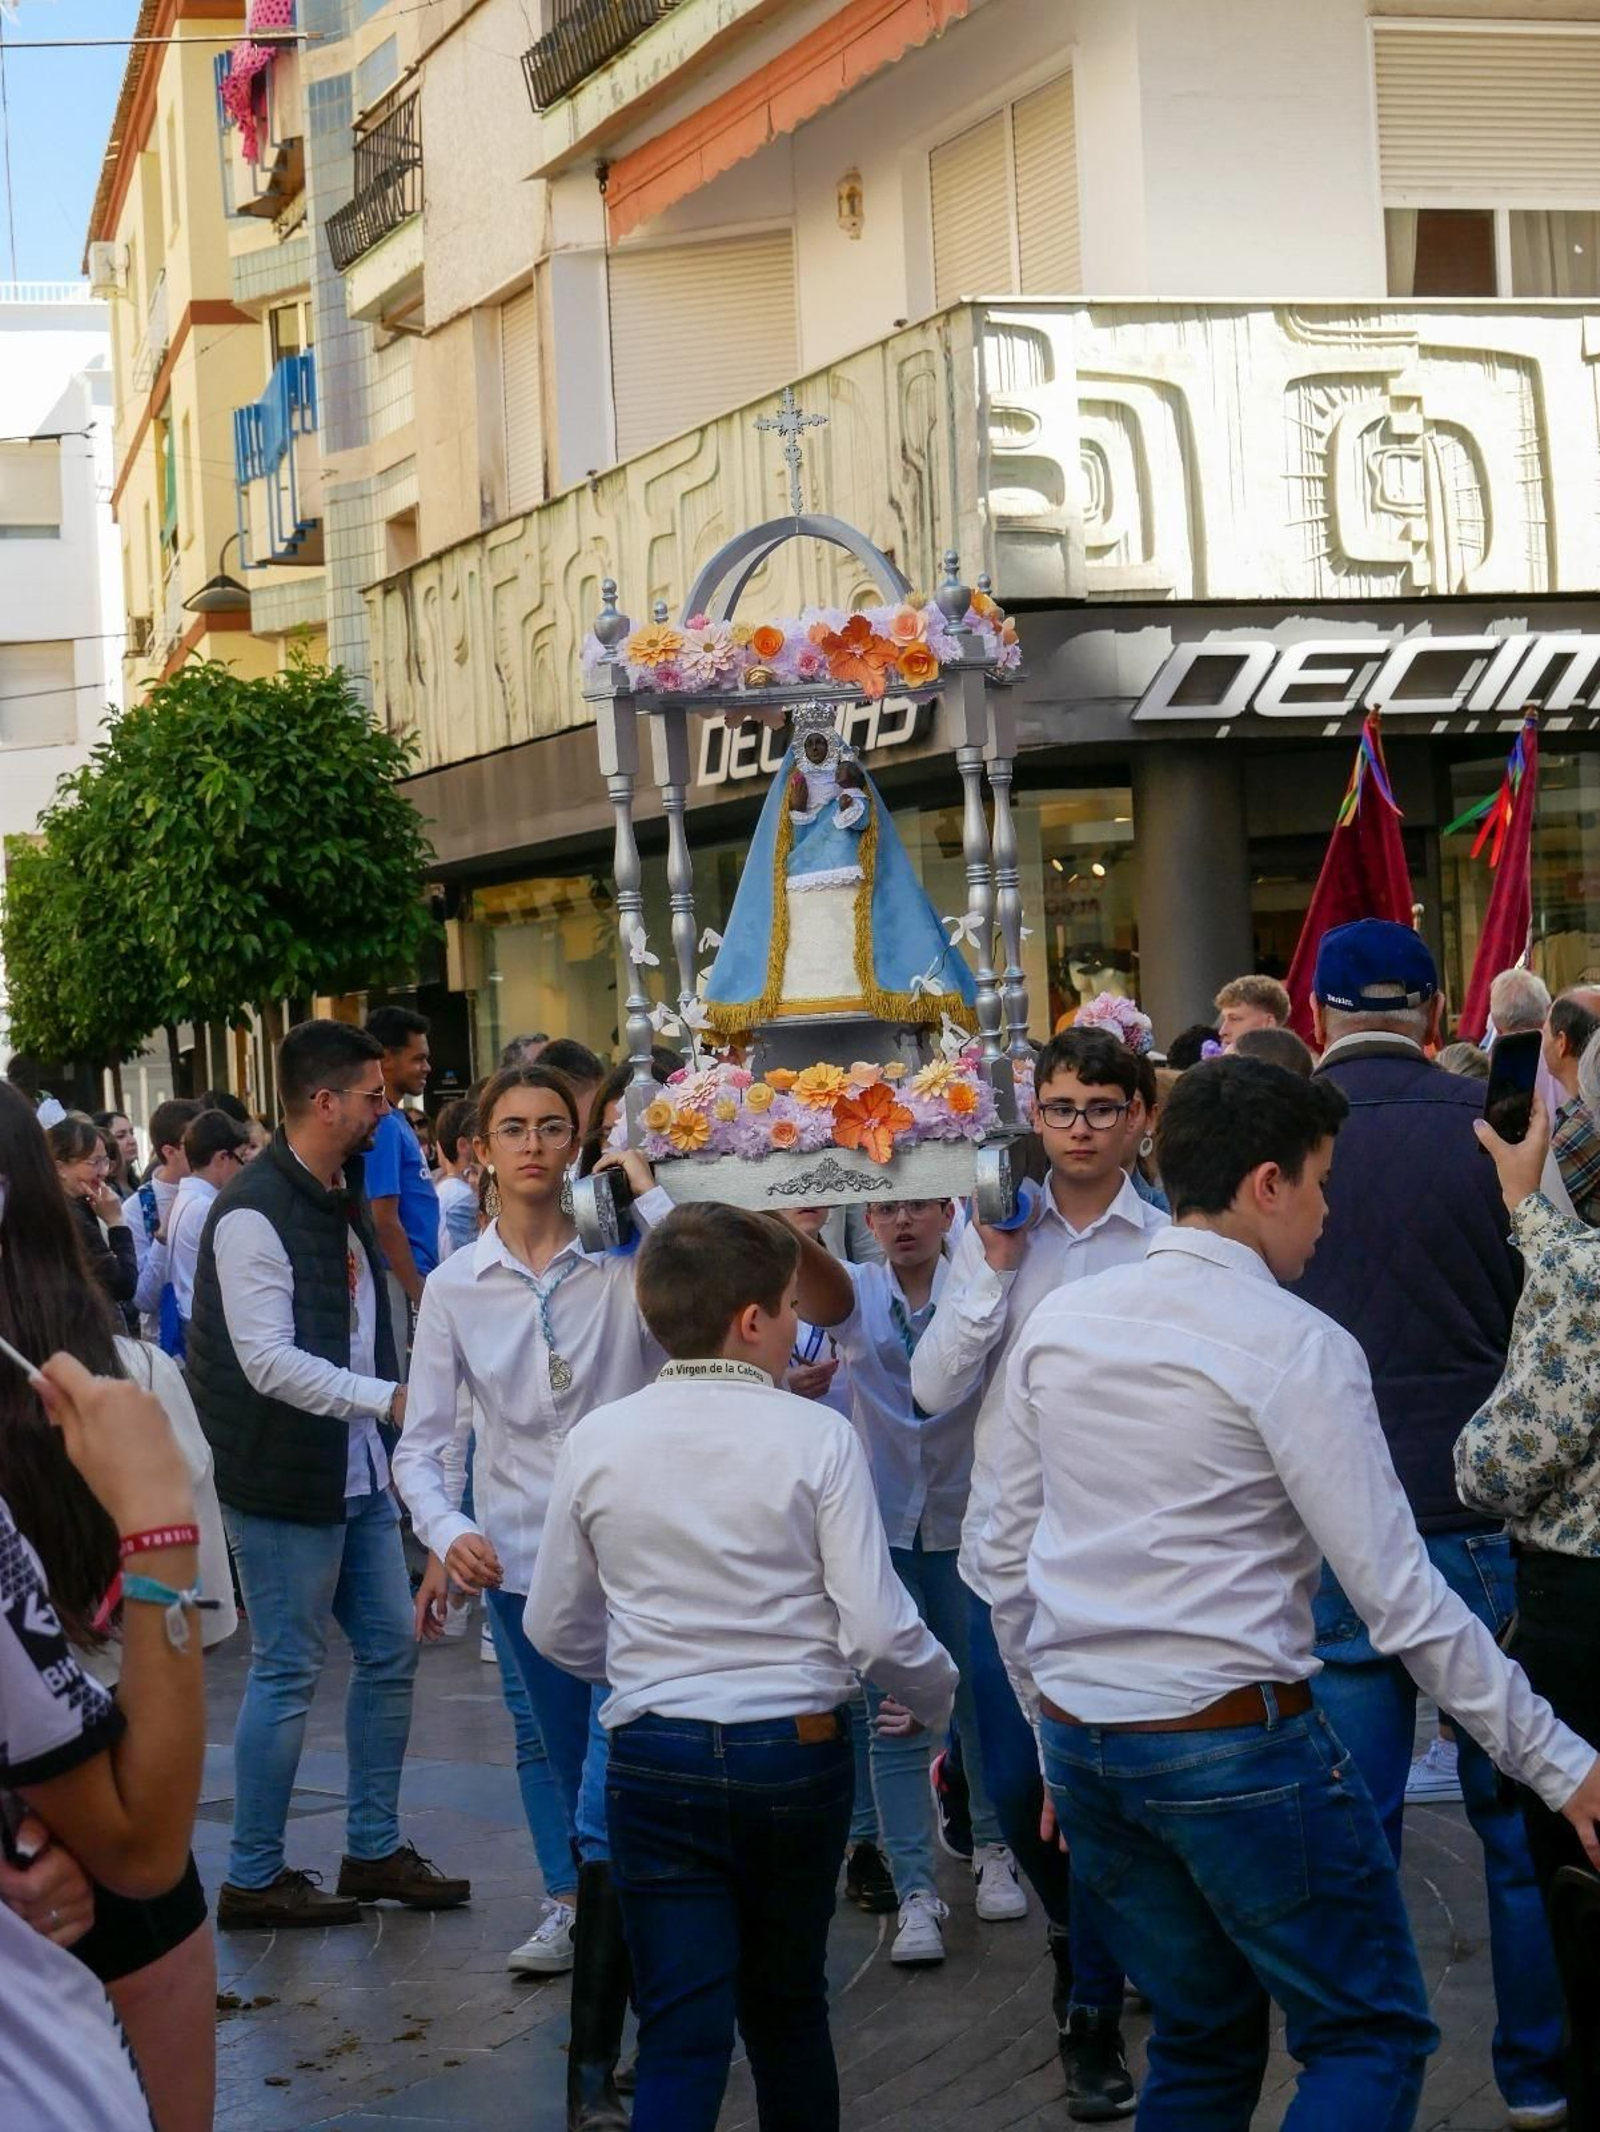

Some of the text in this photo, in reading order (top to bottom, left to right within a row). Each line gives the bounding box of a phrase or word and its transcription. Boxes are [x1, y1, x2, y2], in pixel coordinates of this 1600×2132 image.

[676, 1364, 707, 1377] Virgen
[709, 1363, 723, 1373] de
[725, 1362, 735, 1373] la
[141, 1528, 194, 1547] SIERRA
